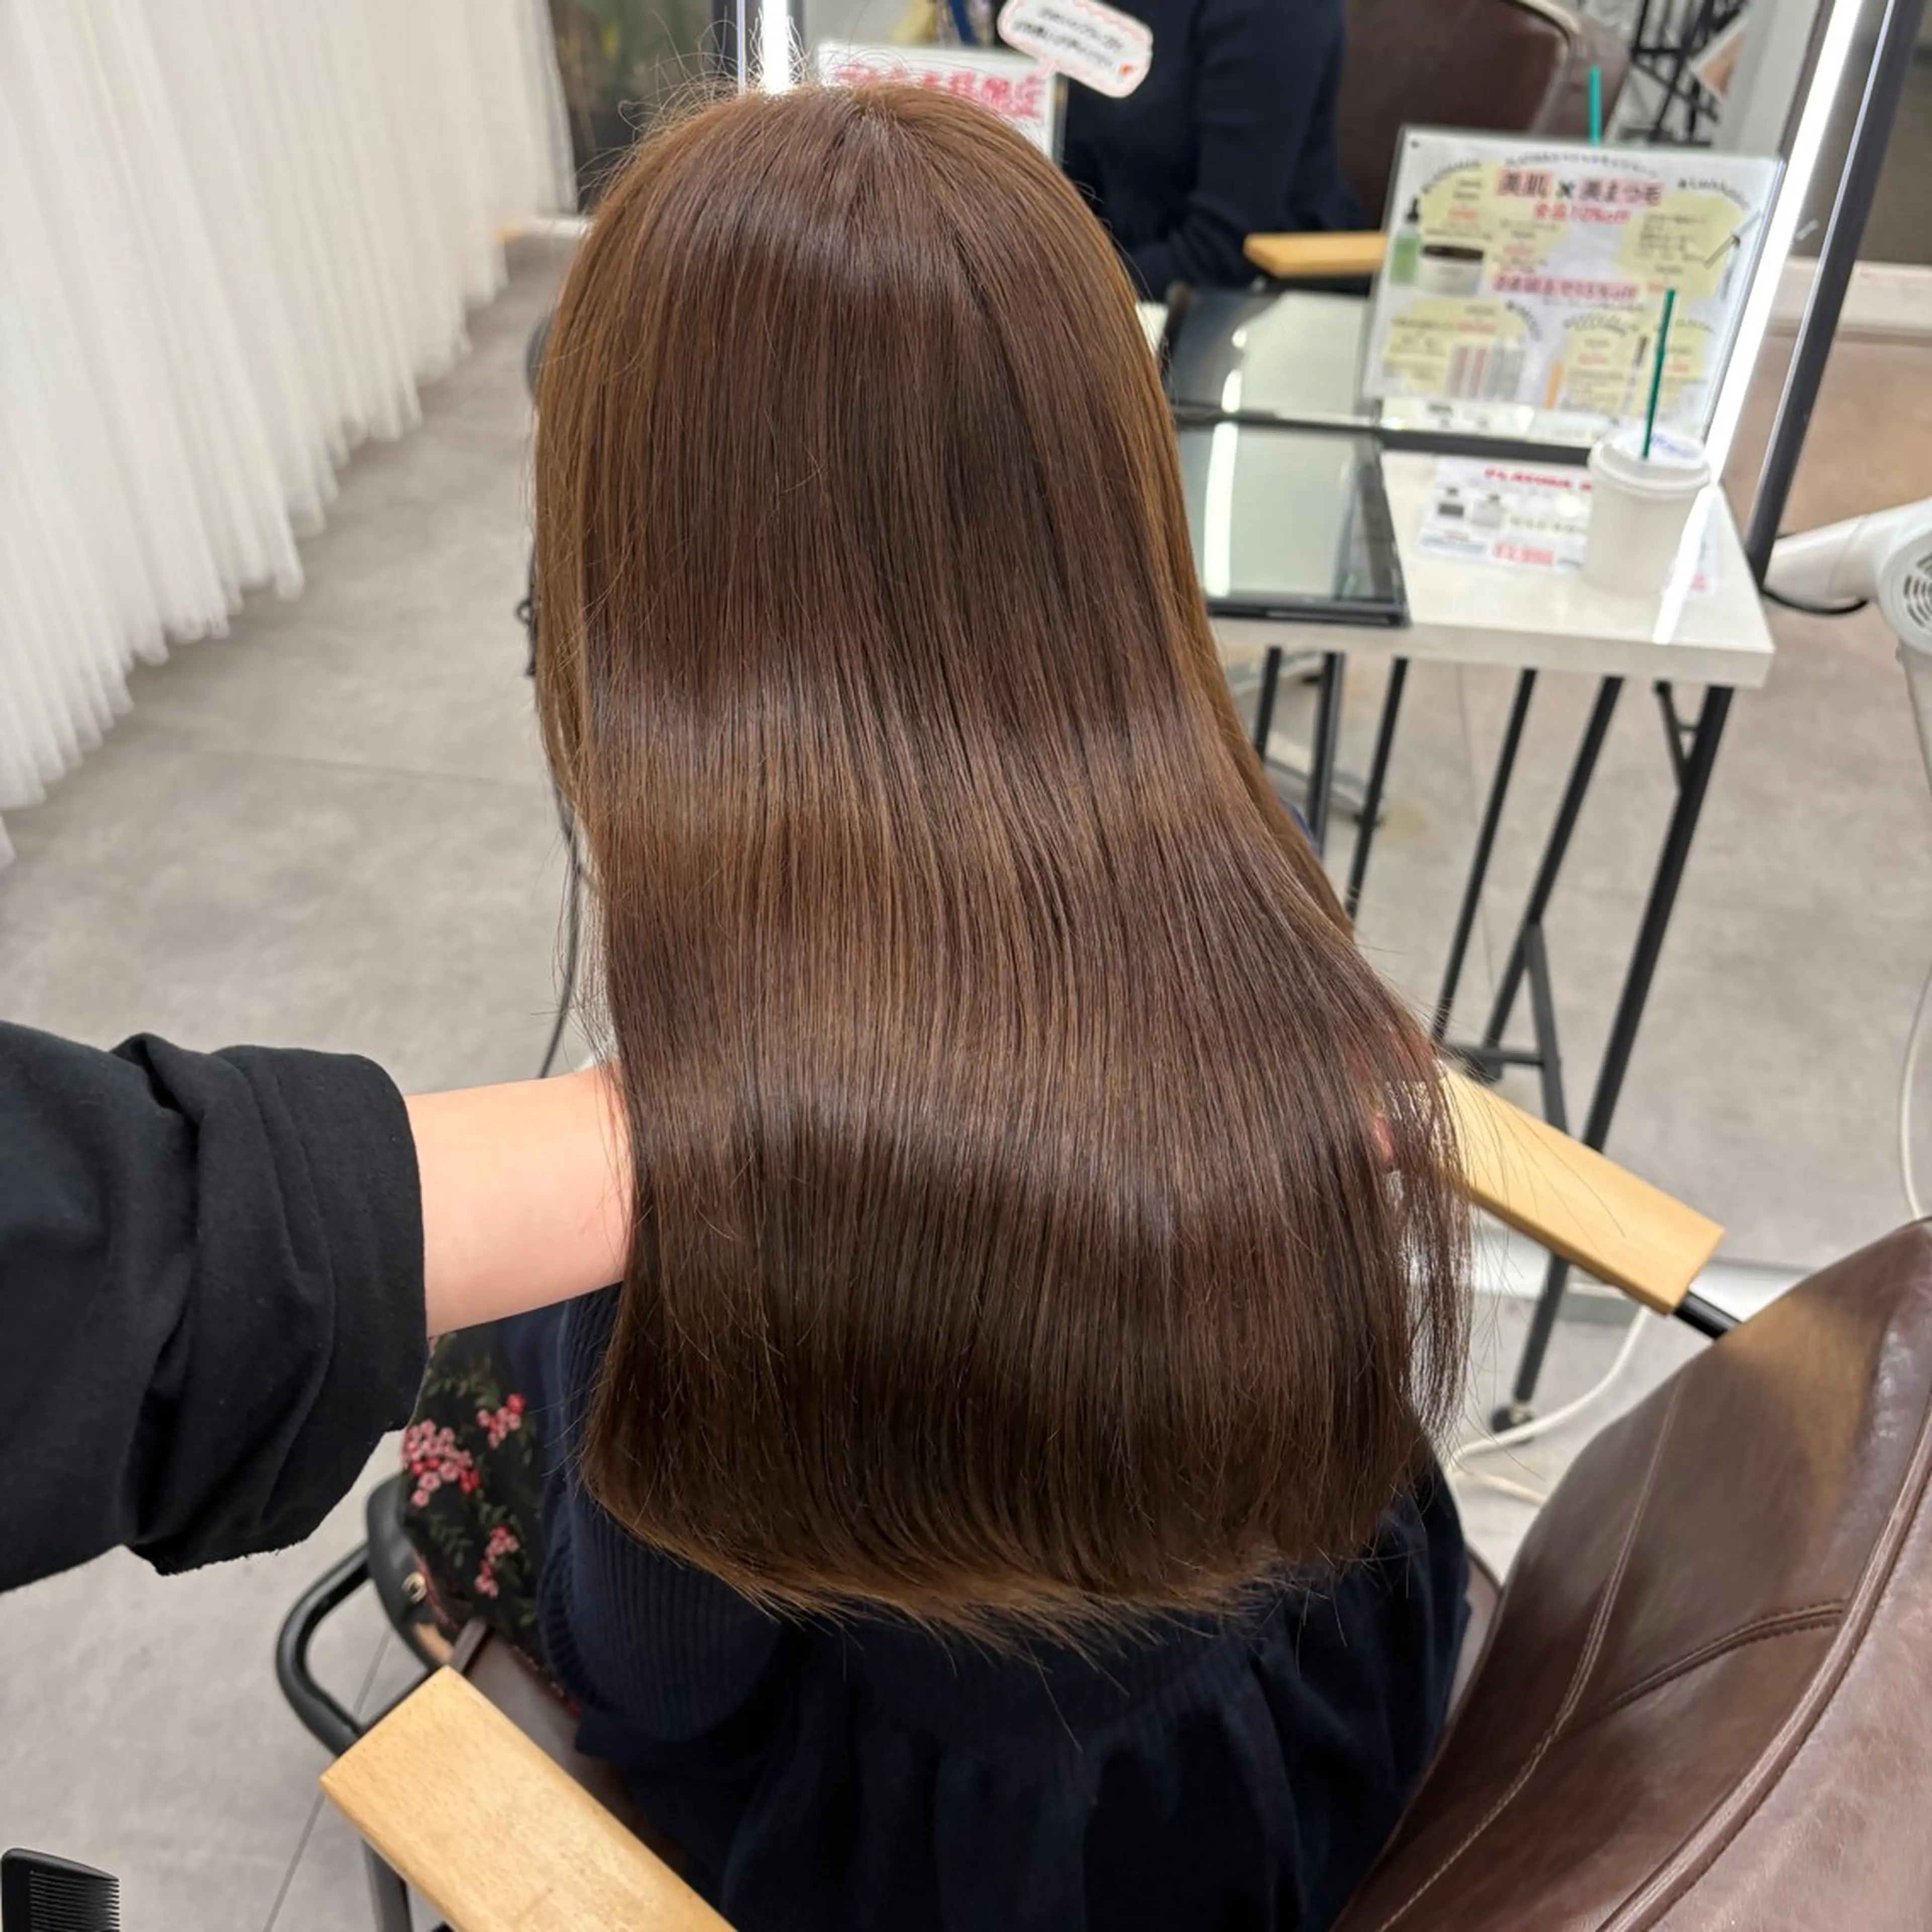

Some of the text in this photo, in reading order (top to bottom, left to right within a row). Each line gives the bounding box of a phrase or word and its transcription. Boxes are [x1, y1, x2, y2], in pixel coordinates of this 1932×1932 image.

[1497, 171, 1550, 196] 美肌
[1579, 179, 1661, 206] 美まつ毛
